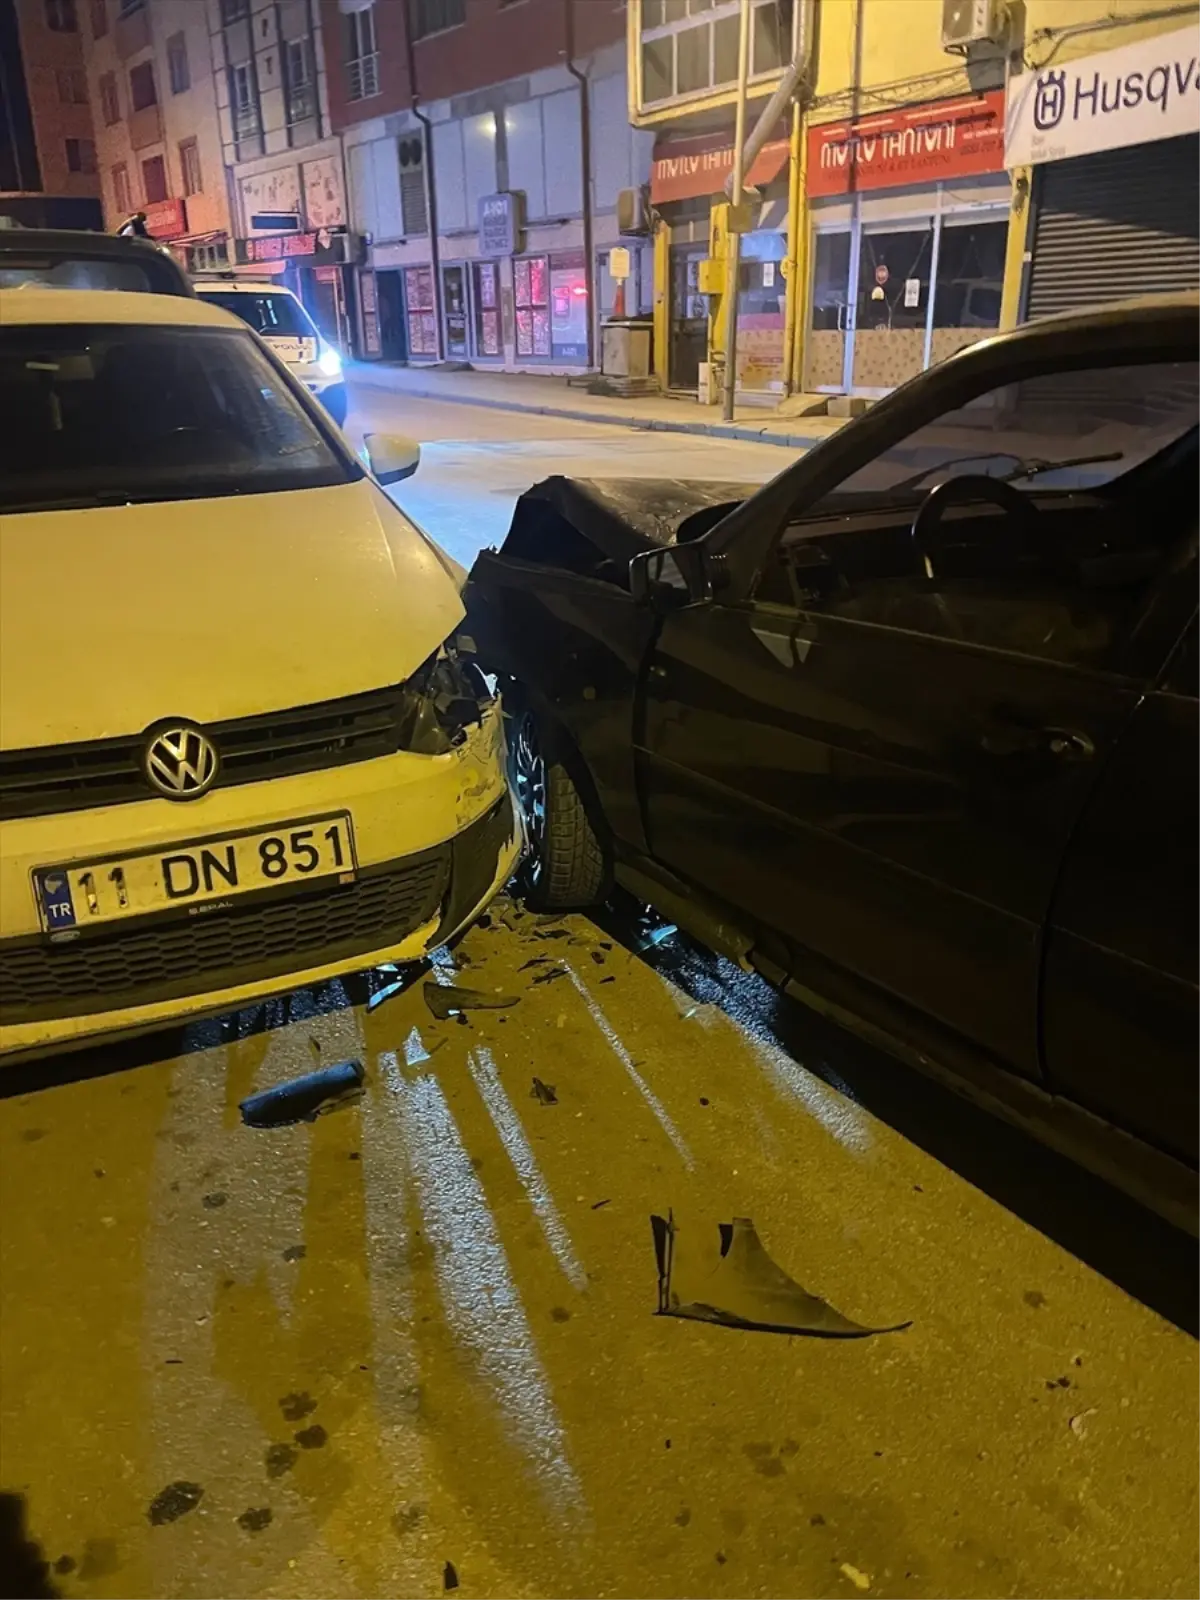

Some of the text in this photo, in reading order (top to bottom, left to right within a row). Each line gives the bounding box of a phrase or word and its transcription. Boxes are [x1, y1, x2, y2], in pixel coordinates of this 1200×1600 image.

[1073, 57, 1200, 121] Husqv
[78, 825, 345, 915] 11 DN 851
[49, 902, 72, 919] TR
